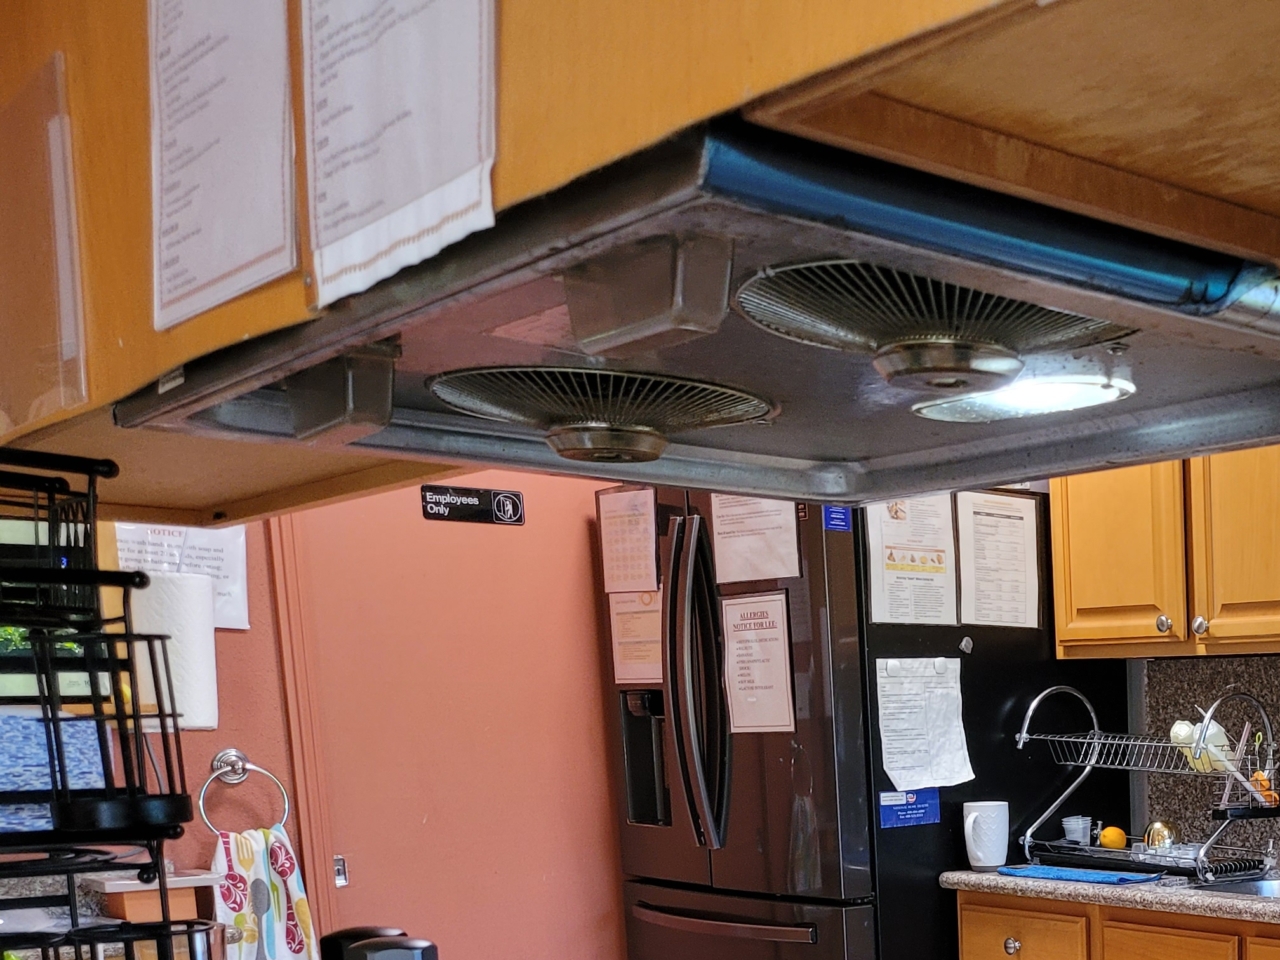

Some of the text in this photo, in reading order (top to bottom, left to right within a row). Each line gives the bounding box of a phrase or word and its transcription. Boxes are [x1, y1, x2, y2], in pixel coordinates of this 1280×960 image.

[426, 492, 479, 505] Employees
[427, 503, 449, 516] Only
[740, 611, 769, 620] ALLERGIES
[733, 623, 752, 631] NOTICE
